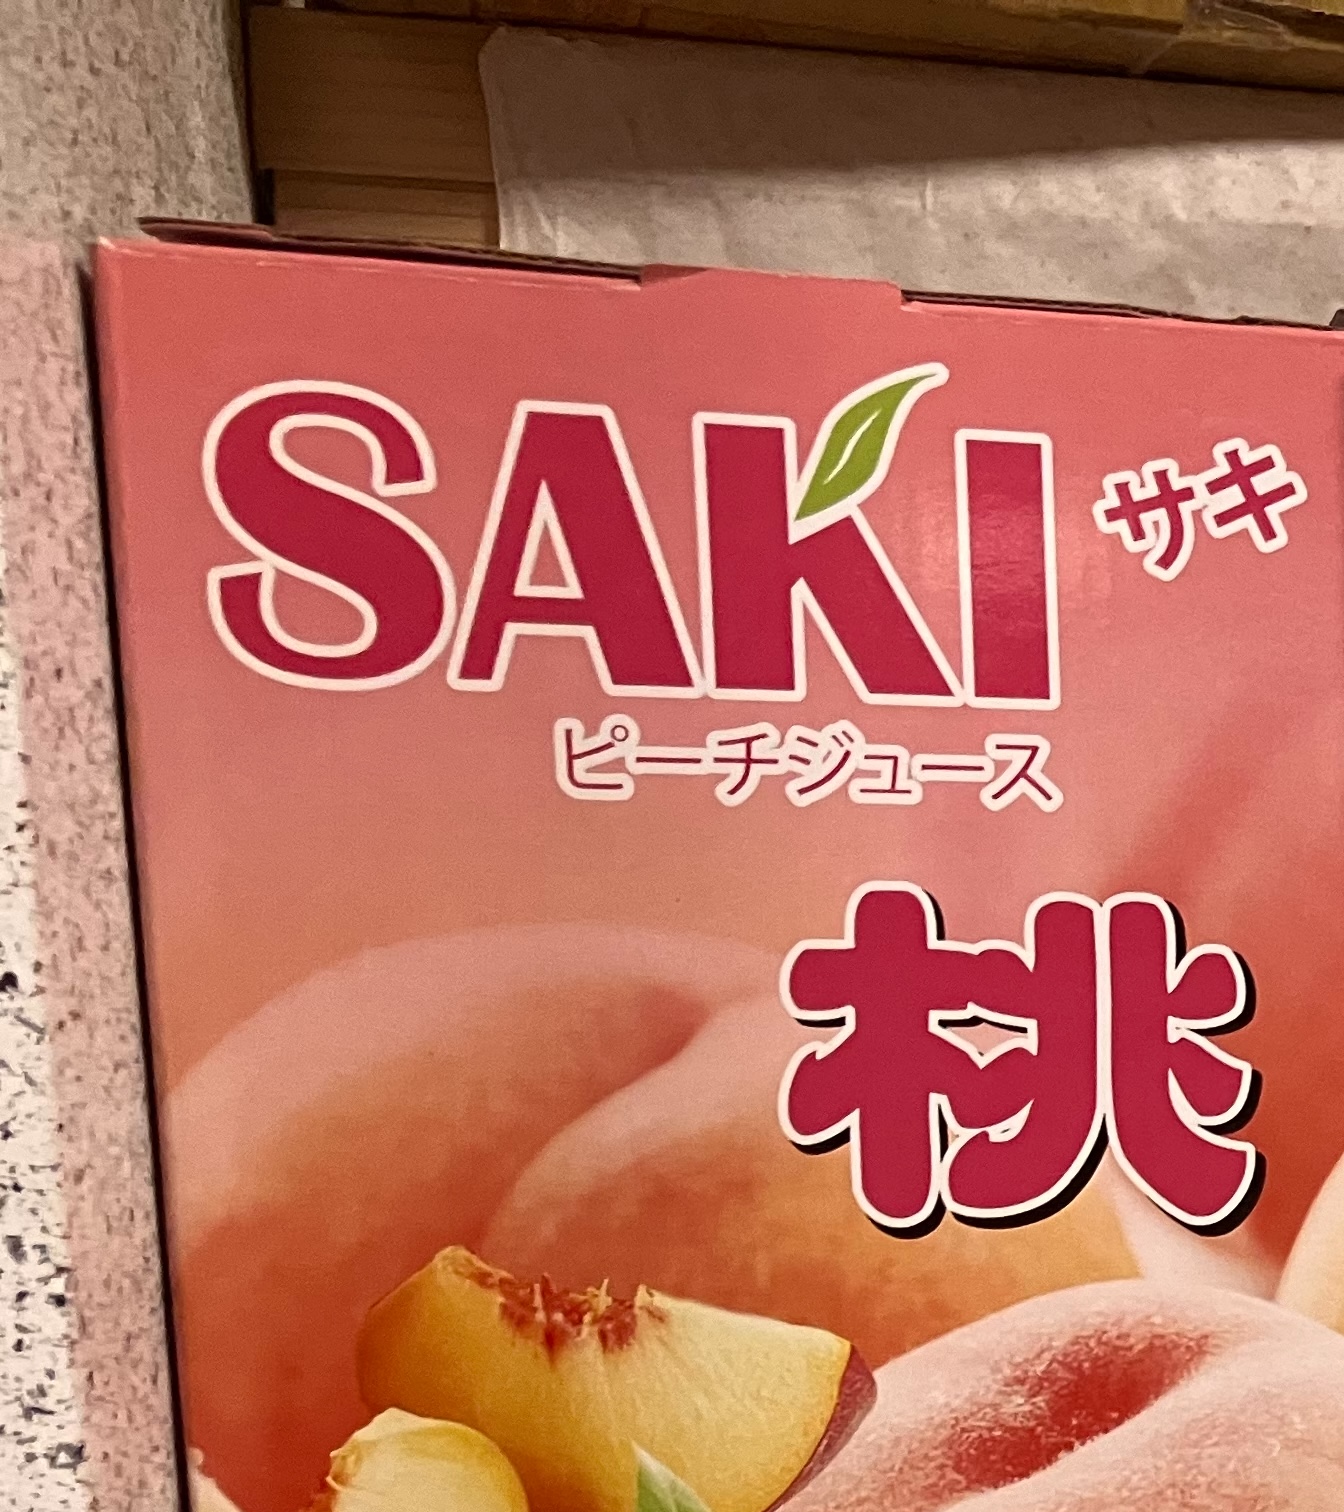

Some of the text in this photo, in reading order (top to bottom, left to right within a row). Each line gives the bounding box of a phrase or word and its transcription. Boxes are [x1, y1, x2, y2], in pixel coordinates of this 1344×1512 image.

[206, 370, 1060, 710] SAKI
[1095, 439, 1307, 580] サキ
[557, 717, 1062, 809] ピーチジュース
[781, 883, 1256, 1232] 桃
